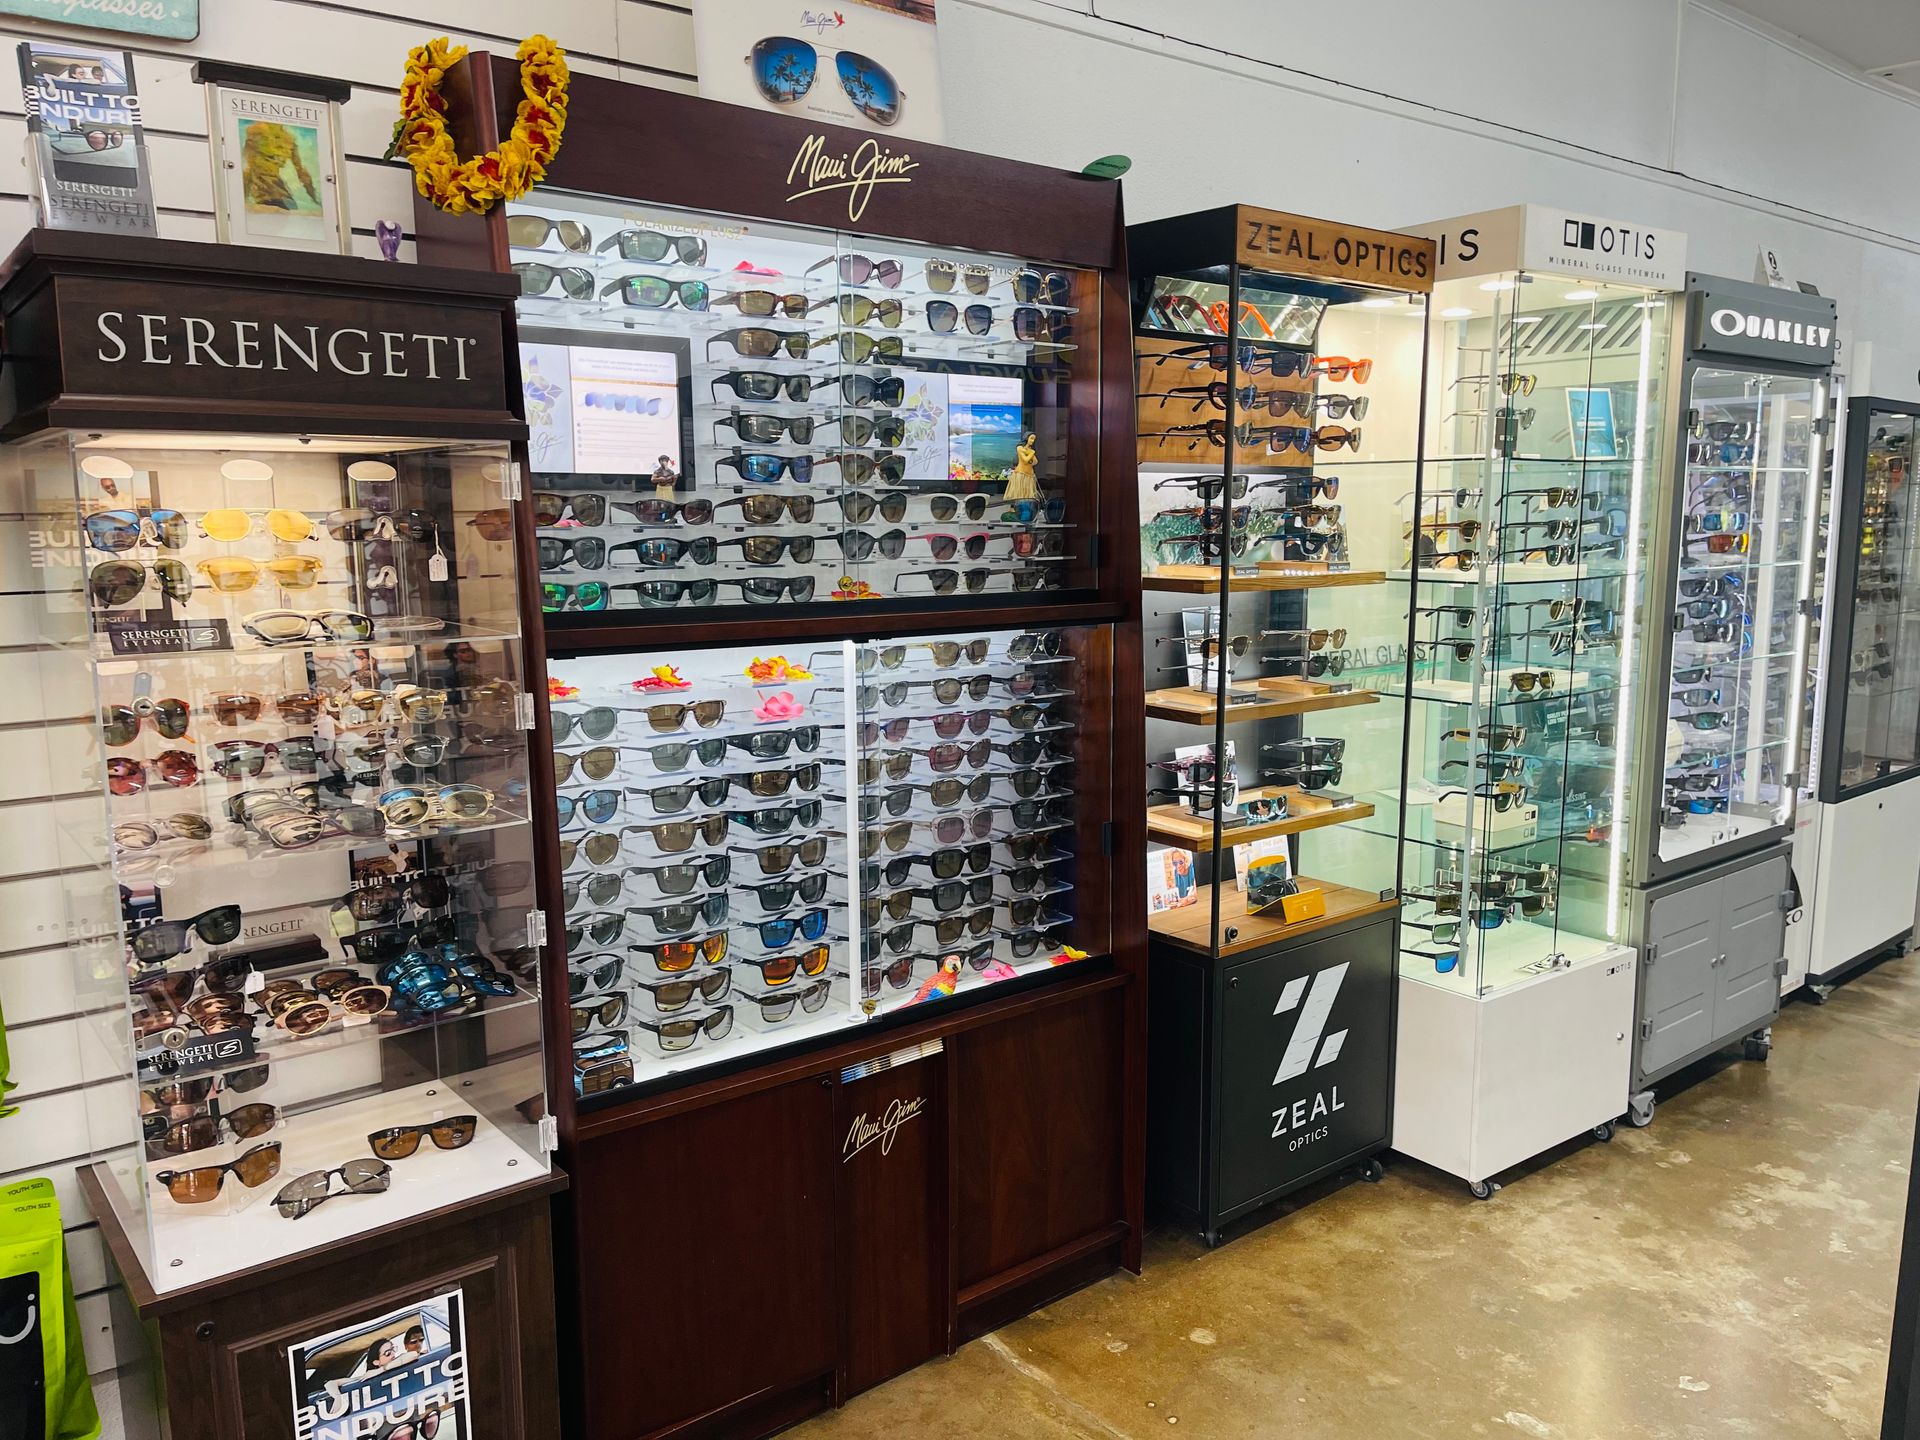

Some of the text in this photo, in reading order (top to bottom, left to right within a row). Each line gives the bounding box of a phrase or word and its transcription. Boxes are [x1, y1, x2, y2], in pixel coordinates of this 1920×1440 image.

[26, 85, 141, 110] BUILT TO
[230, 97, 319, 121] SERENGETI
[56, 181, 134, 197] SERENGETI
[786, 134, 920, 222] Maui Jim
[50, 194, 151, 216] SERENGETI
[1247, 221, 1428, 279] ZEAL OPTICS
[1439, 228, 1480, 266] IS
[1600, 226, 1655, 260] OTIS
[1549, 256, 1665, 280] MINERAL GLASS EYEWEAR
[97, 311, 472, 381] SERENGETI
[121, 629, 188, 641] SERENGETI
[123, 638, 191, 648] EYEWEAR
[1312, 643, 1427, 669] NERAL GLAS
[243, 919, 301, 939] RENGETI
[1616, 961, 1631, 974] OTIS
[147, 1043, 212, 1064] SERENGETI
[149, 1053, 214, 1072] EYEWEAR
[1271, 1085, 1345, 1139] ZEAL
[842, 1098, 927, 1156] Maui Jim
[1288, 1125, 1328, 1152] OPTICS
[8, 1182, 44, 1196] YOUTH SIZE
[14, 1202, 51, 1212] YOUTH SIZE
[297, 1351, 464, 1432] BUILT TO
